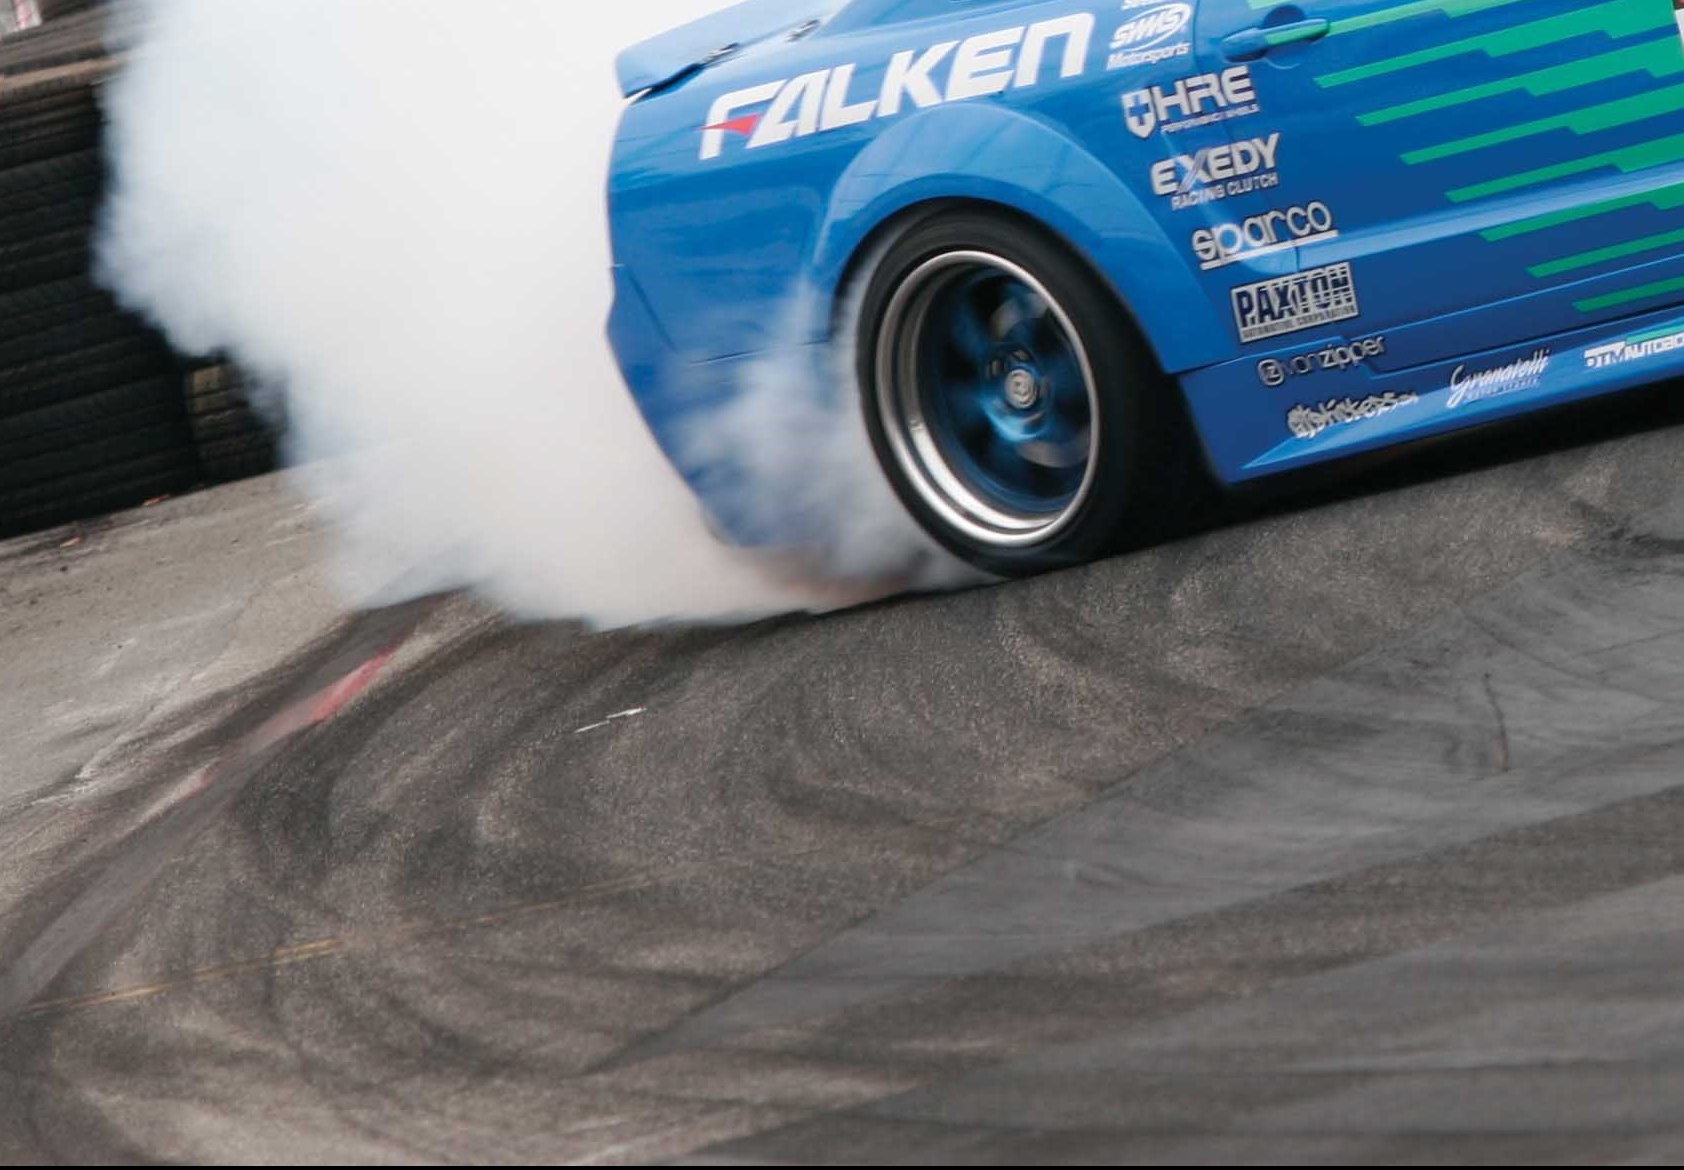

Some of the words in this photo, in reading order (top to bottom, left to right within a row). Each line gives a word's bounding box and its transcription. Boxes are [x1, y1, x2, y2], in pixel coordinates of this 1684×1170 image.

[699, 12, 1096, 161] FALKEN
[1150, 64, 1257, 121] HRE
[1151, 132, 1281, 196] EXEDY
[1171, 184, 1226, 212] RACING
[1226, 172, 1279, 196] CLUTCH
[1191, 201, 1333, 264] sparco
[1234, 264, 1353, 328] PAXTON
